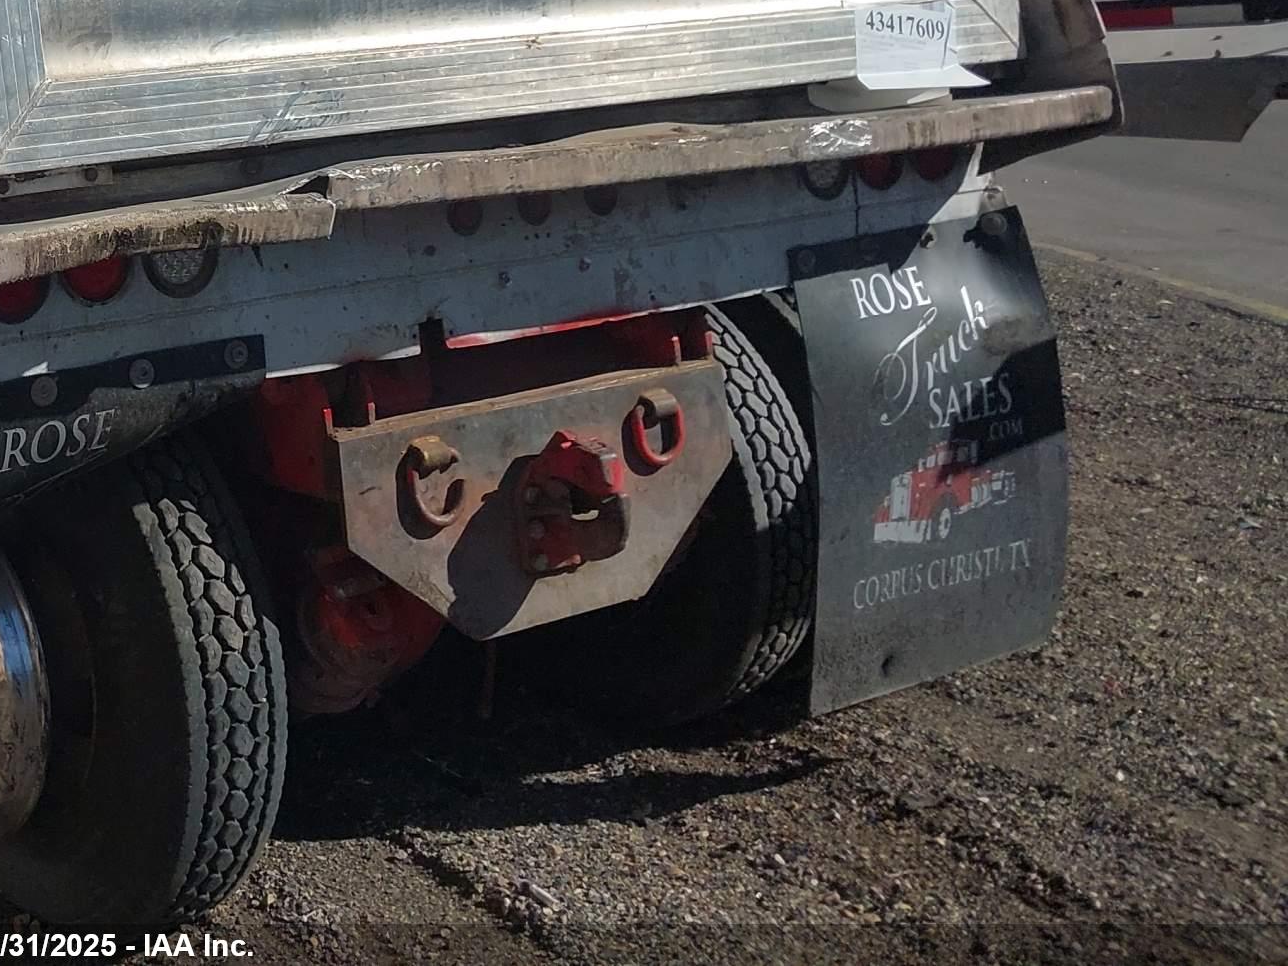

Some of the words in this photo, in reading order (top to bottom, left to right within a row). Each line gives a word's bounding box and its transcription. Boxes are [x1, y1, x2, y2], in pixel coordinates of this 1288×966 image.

[865, 9, 945, 41] 43417609
[850, 266, 932, 319] ROSE
[873, 286, 992, 426] Truck
[929, 372, 1012, 429] SALES
[853, 563, 923, 609] CORPUS
